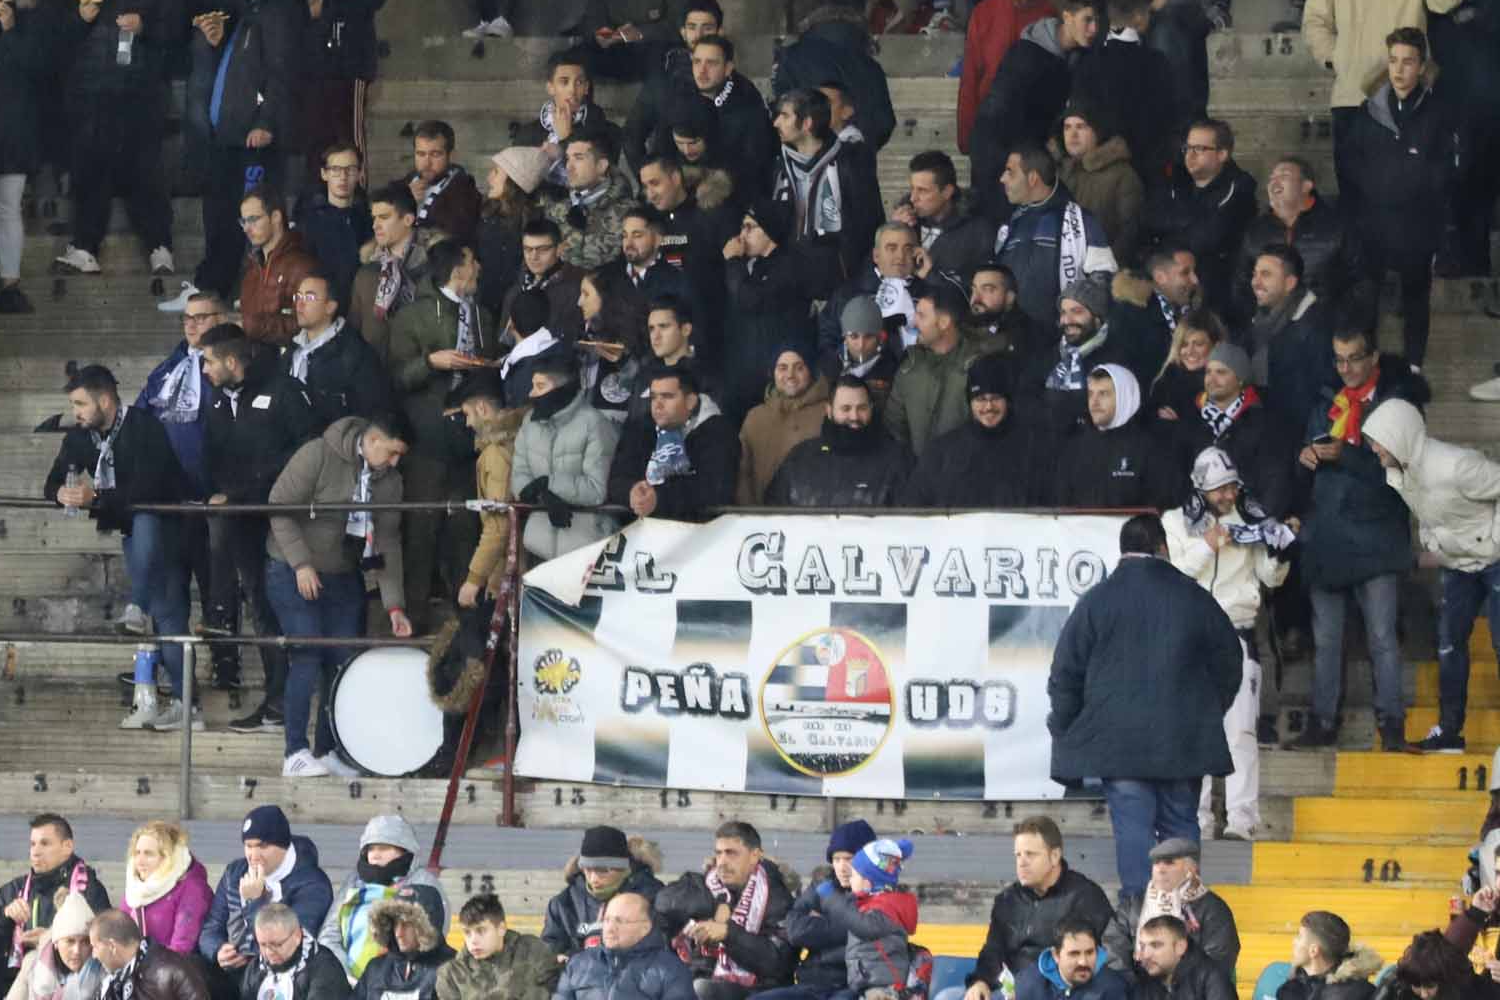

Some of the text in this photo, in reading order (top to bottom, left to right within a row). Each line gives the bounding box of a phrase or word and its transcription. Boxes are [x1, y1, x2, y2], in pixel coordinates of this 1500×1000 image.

[736, 531, 1107, 598] CALVARIO
[622, 662, 750, 720] PEÑA
[906, 679, 1017, 729] UDS
[554, 787, 587, 807] 13
